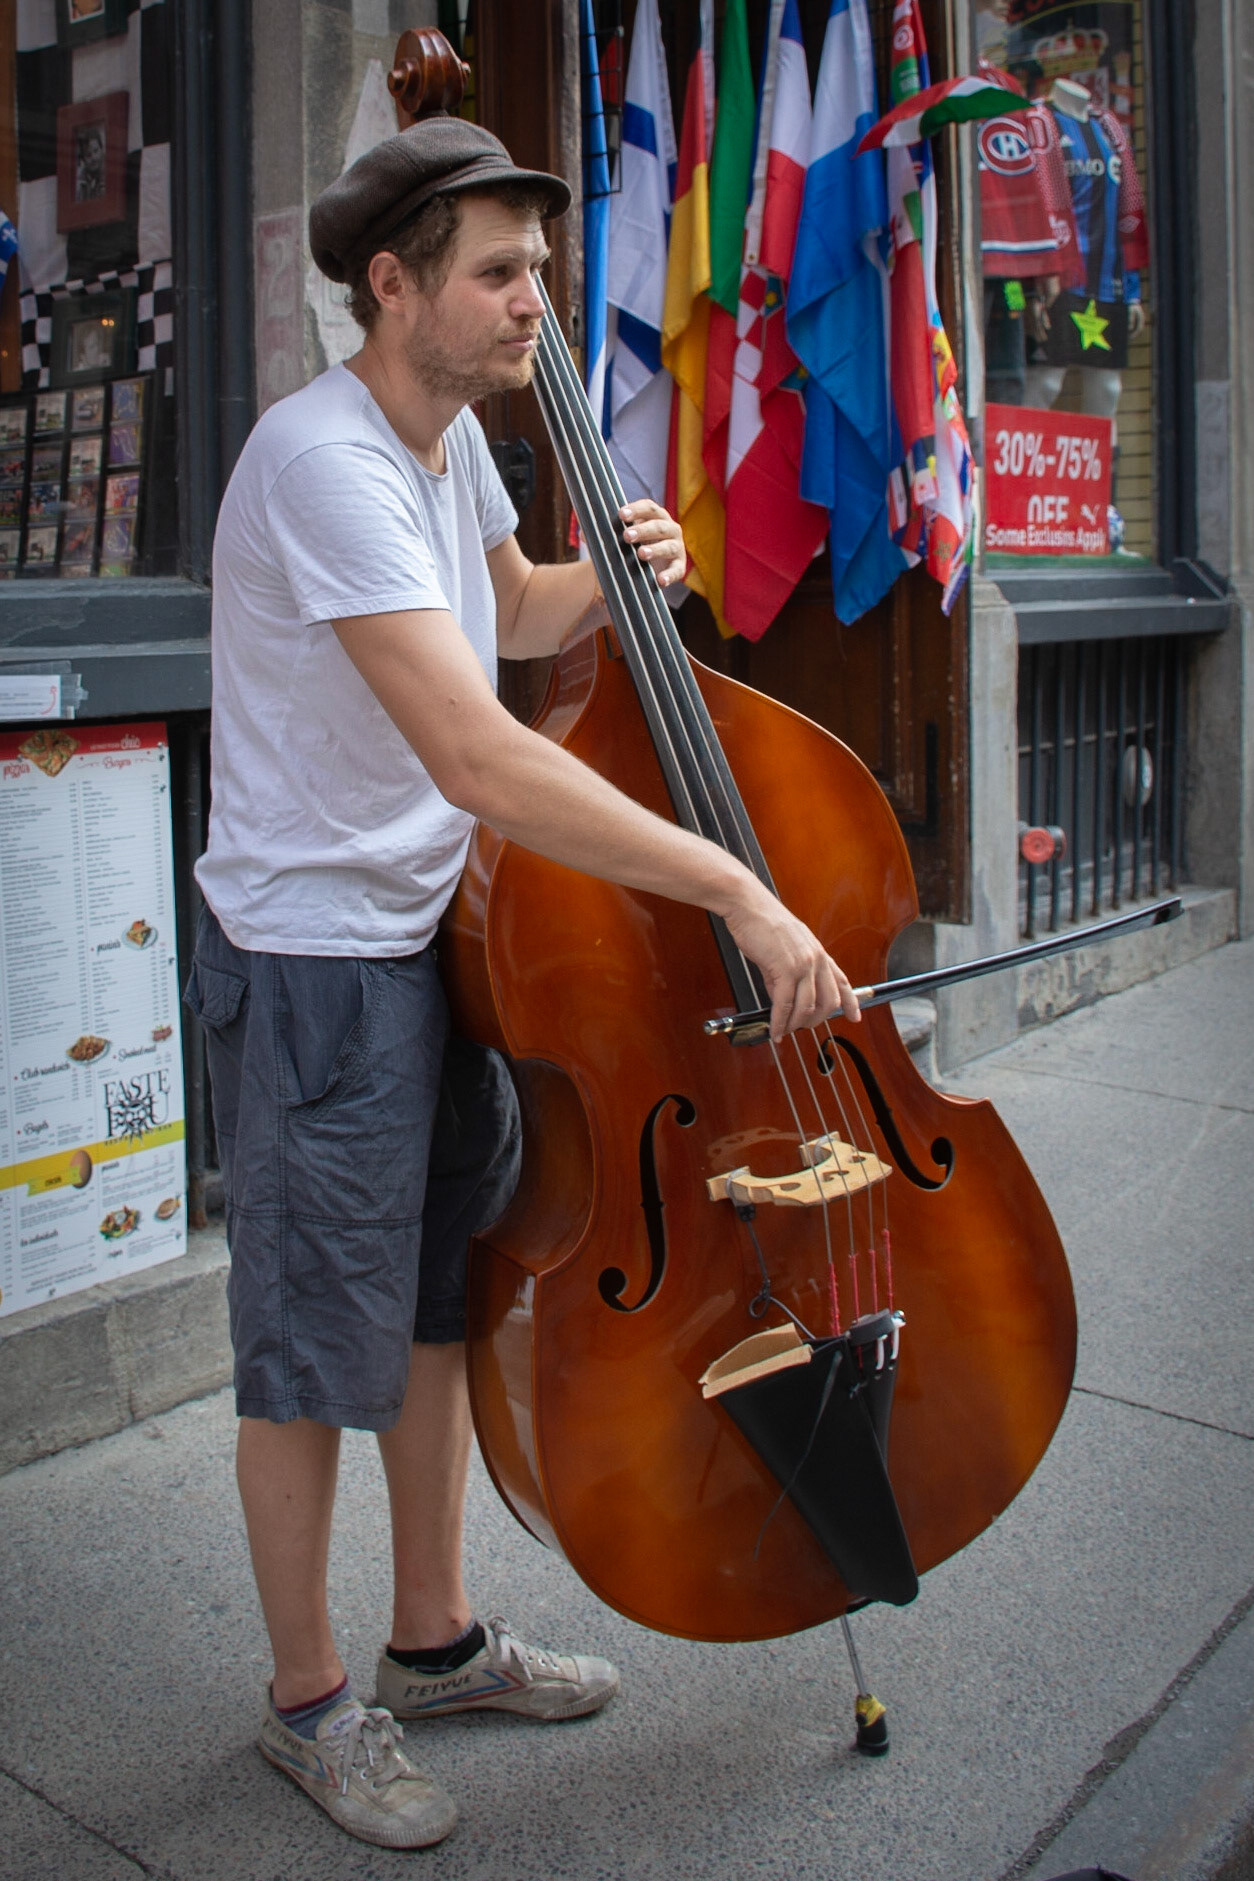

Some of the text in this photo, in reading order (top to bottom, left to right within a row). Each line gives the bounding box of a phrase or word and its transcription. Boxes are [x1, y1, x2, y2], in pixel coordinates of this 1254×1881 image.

[994, 430, 1101, 480] 30%-75%
[986, 523, 1026, 547] Some
[103, 1068, 171, 1108] FASTE
[404, 1673, 472, 1698] FEIYUE
